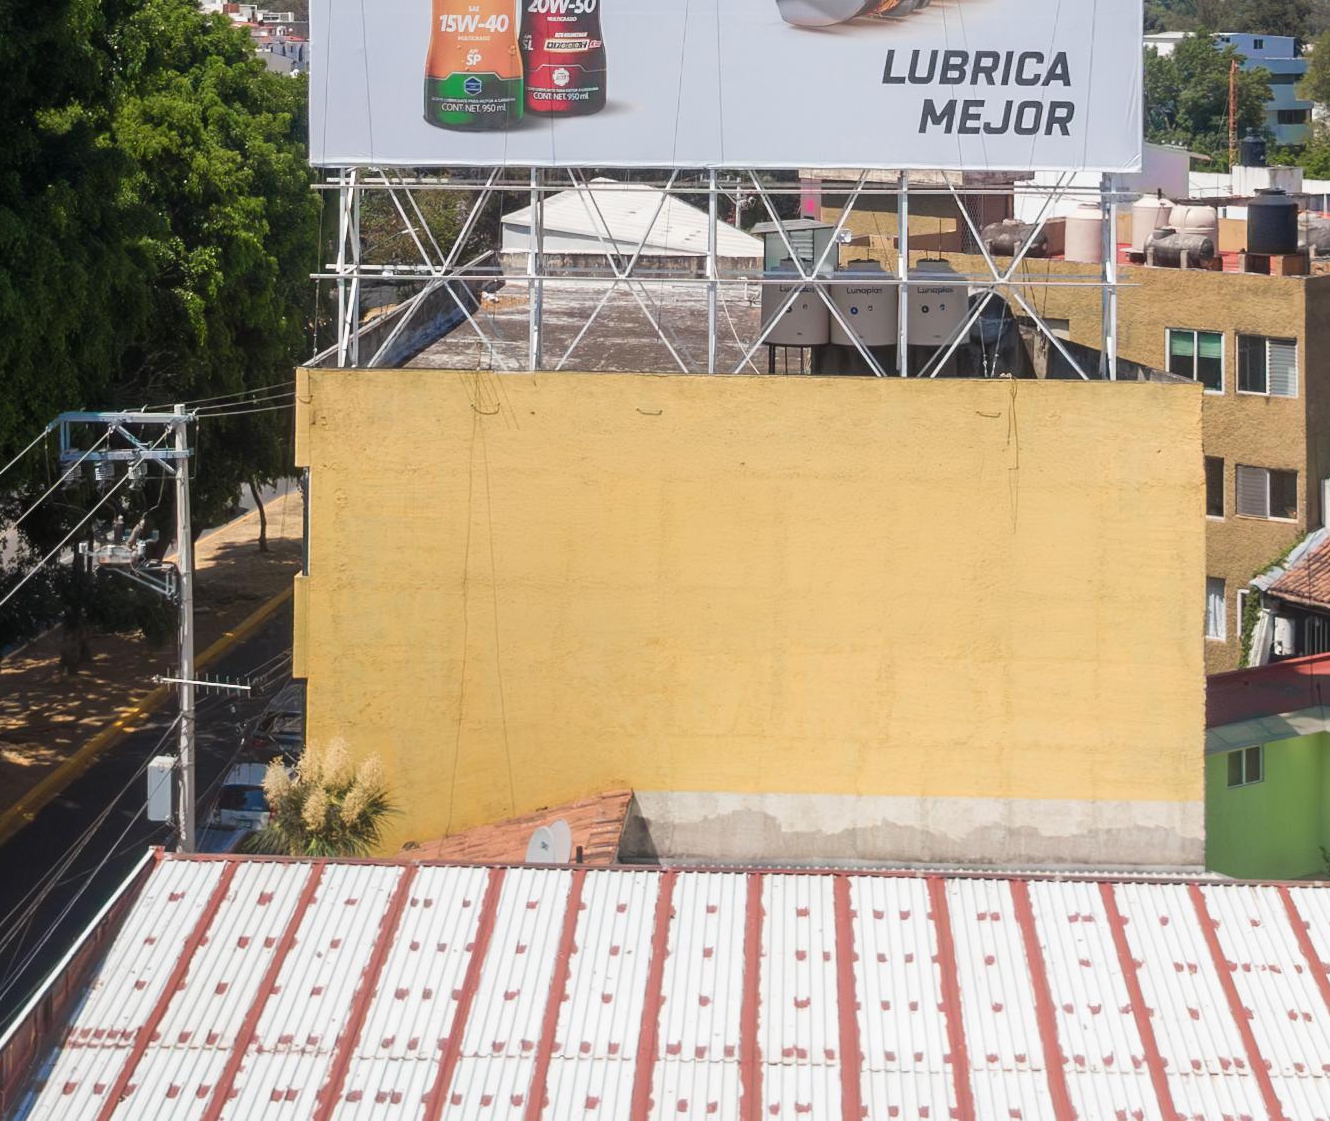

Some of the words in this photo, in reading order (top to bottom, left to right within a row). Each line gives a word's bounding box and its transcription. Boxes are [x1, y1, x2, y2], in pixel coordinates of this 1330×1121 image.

[439, 14, 509, 33] 15W-40
[465, 53, 482, 66] SP
[882, 49, 1071, 86] LUBRICA
[481, 103, 496, 113] 950
[918, 98, 1075, 136] MEJOR
